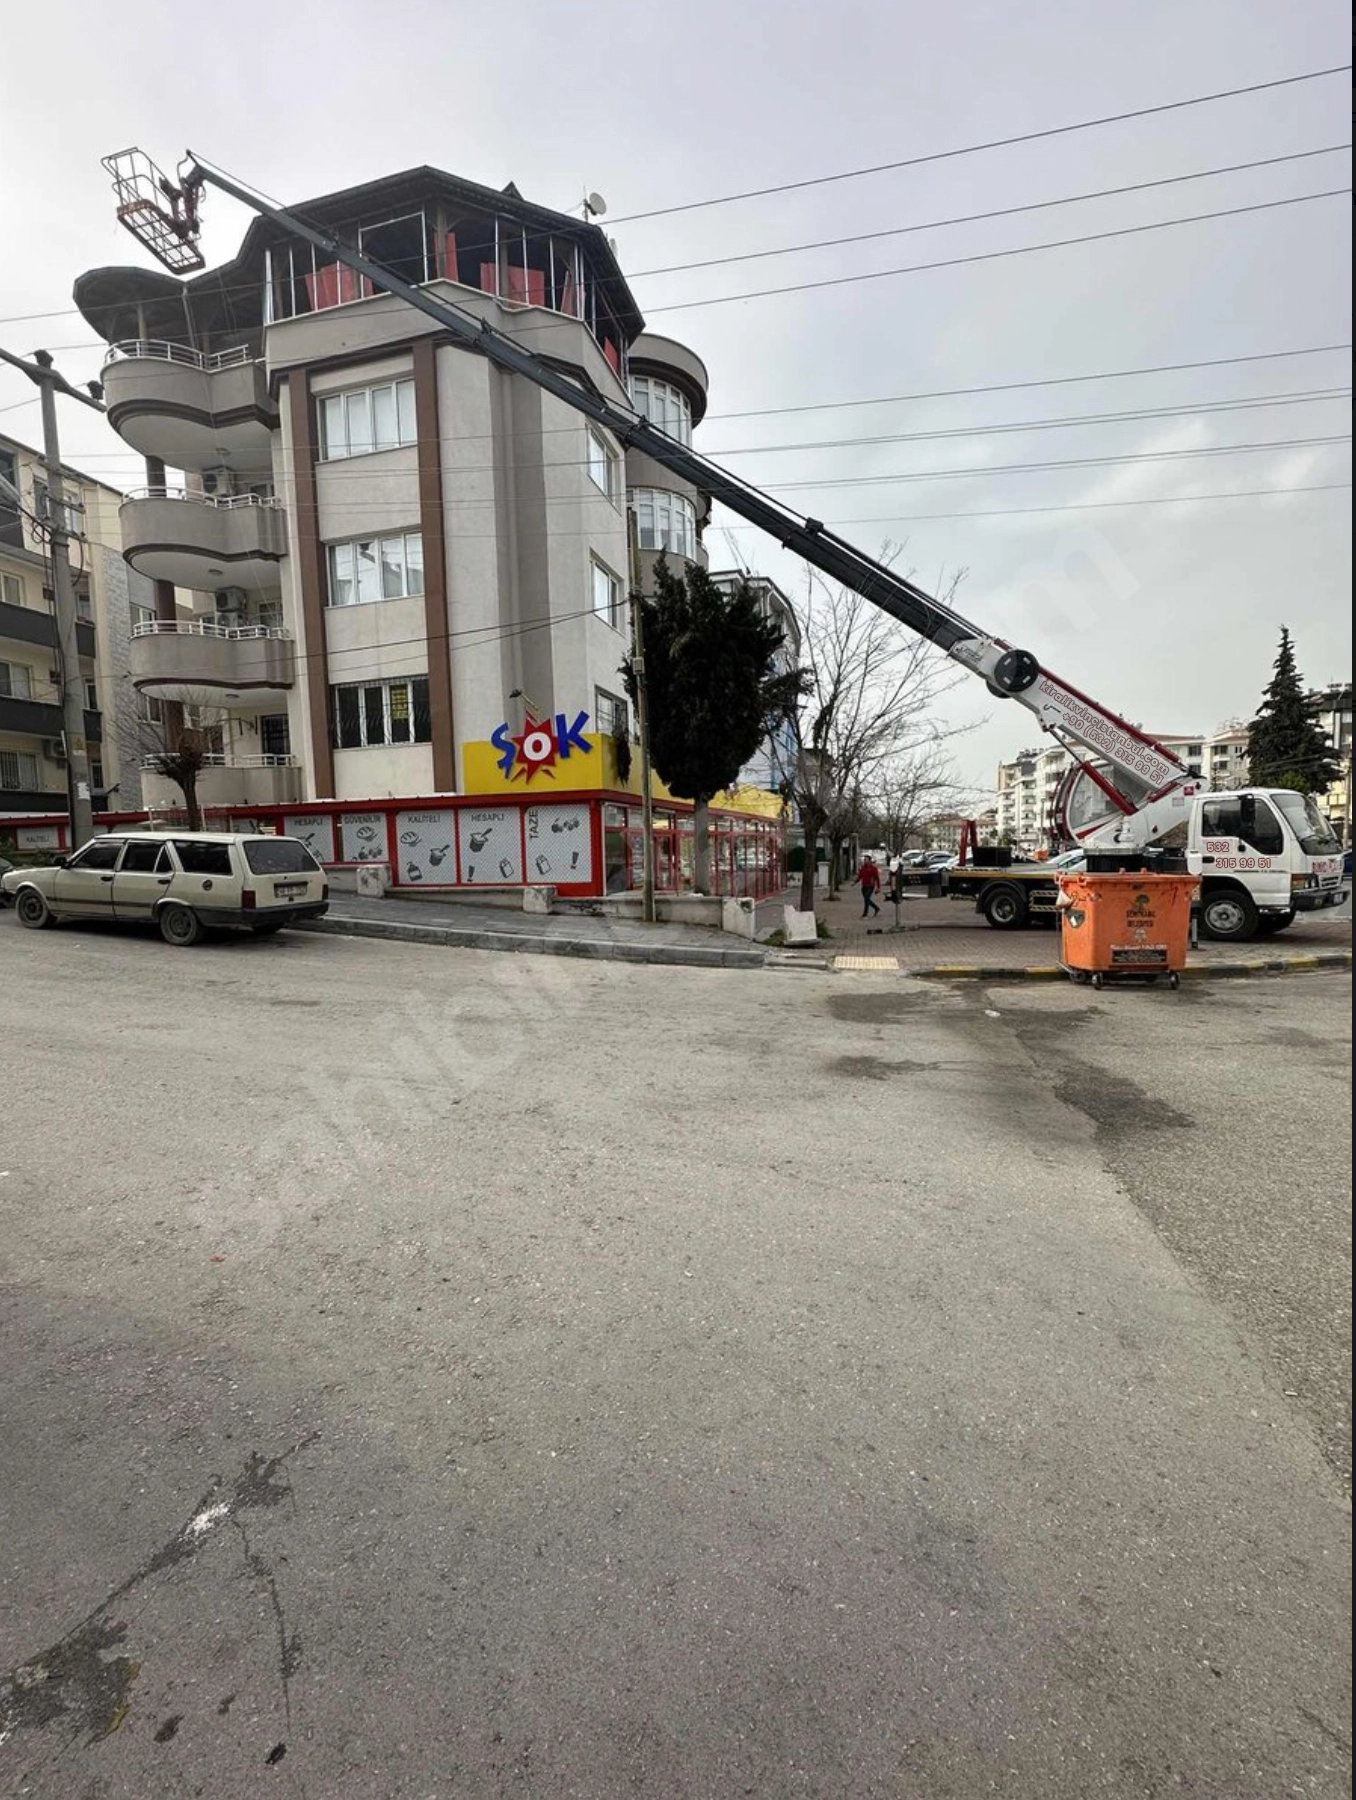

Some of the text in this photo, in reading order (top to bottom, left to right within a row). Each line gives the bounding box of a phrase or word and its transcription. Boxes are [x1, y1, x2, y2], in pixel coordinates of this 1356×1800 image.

[490, 710, 593, 779] ŞOK
[1039, 681, 1170, 775] kiralikvincistanbul.com
[1062, 711, 1164, 785] +90 (532) 315 99 51
[528, 809, 539, 839] TAZE
[1206, 842, 1230, 853] 532
[1215, 857, 1272, 869] 315 99 51
